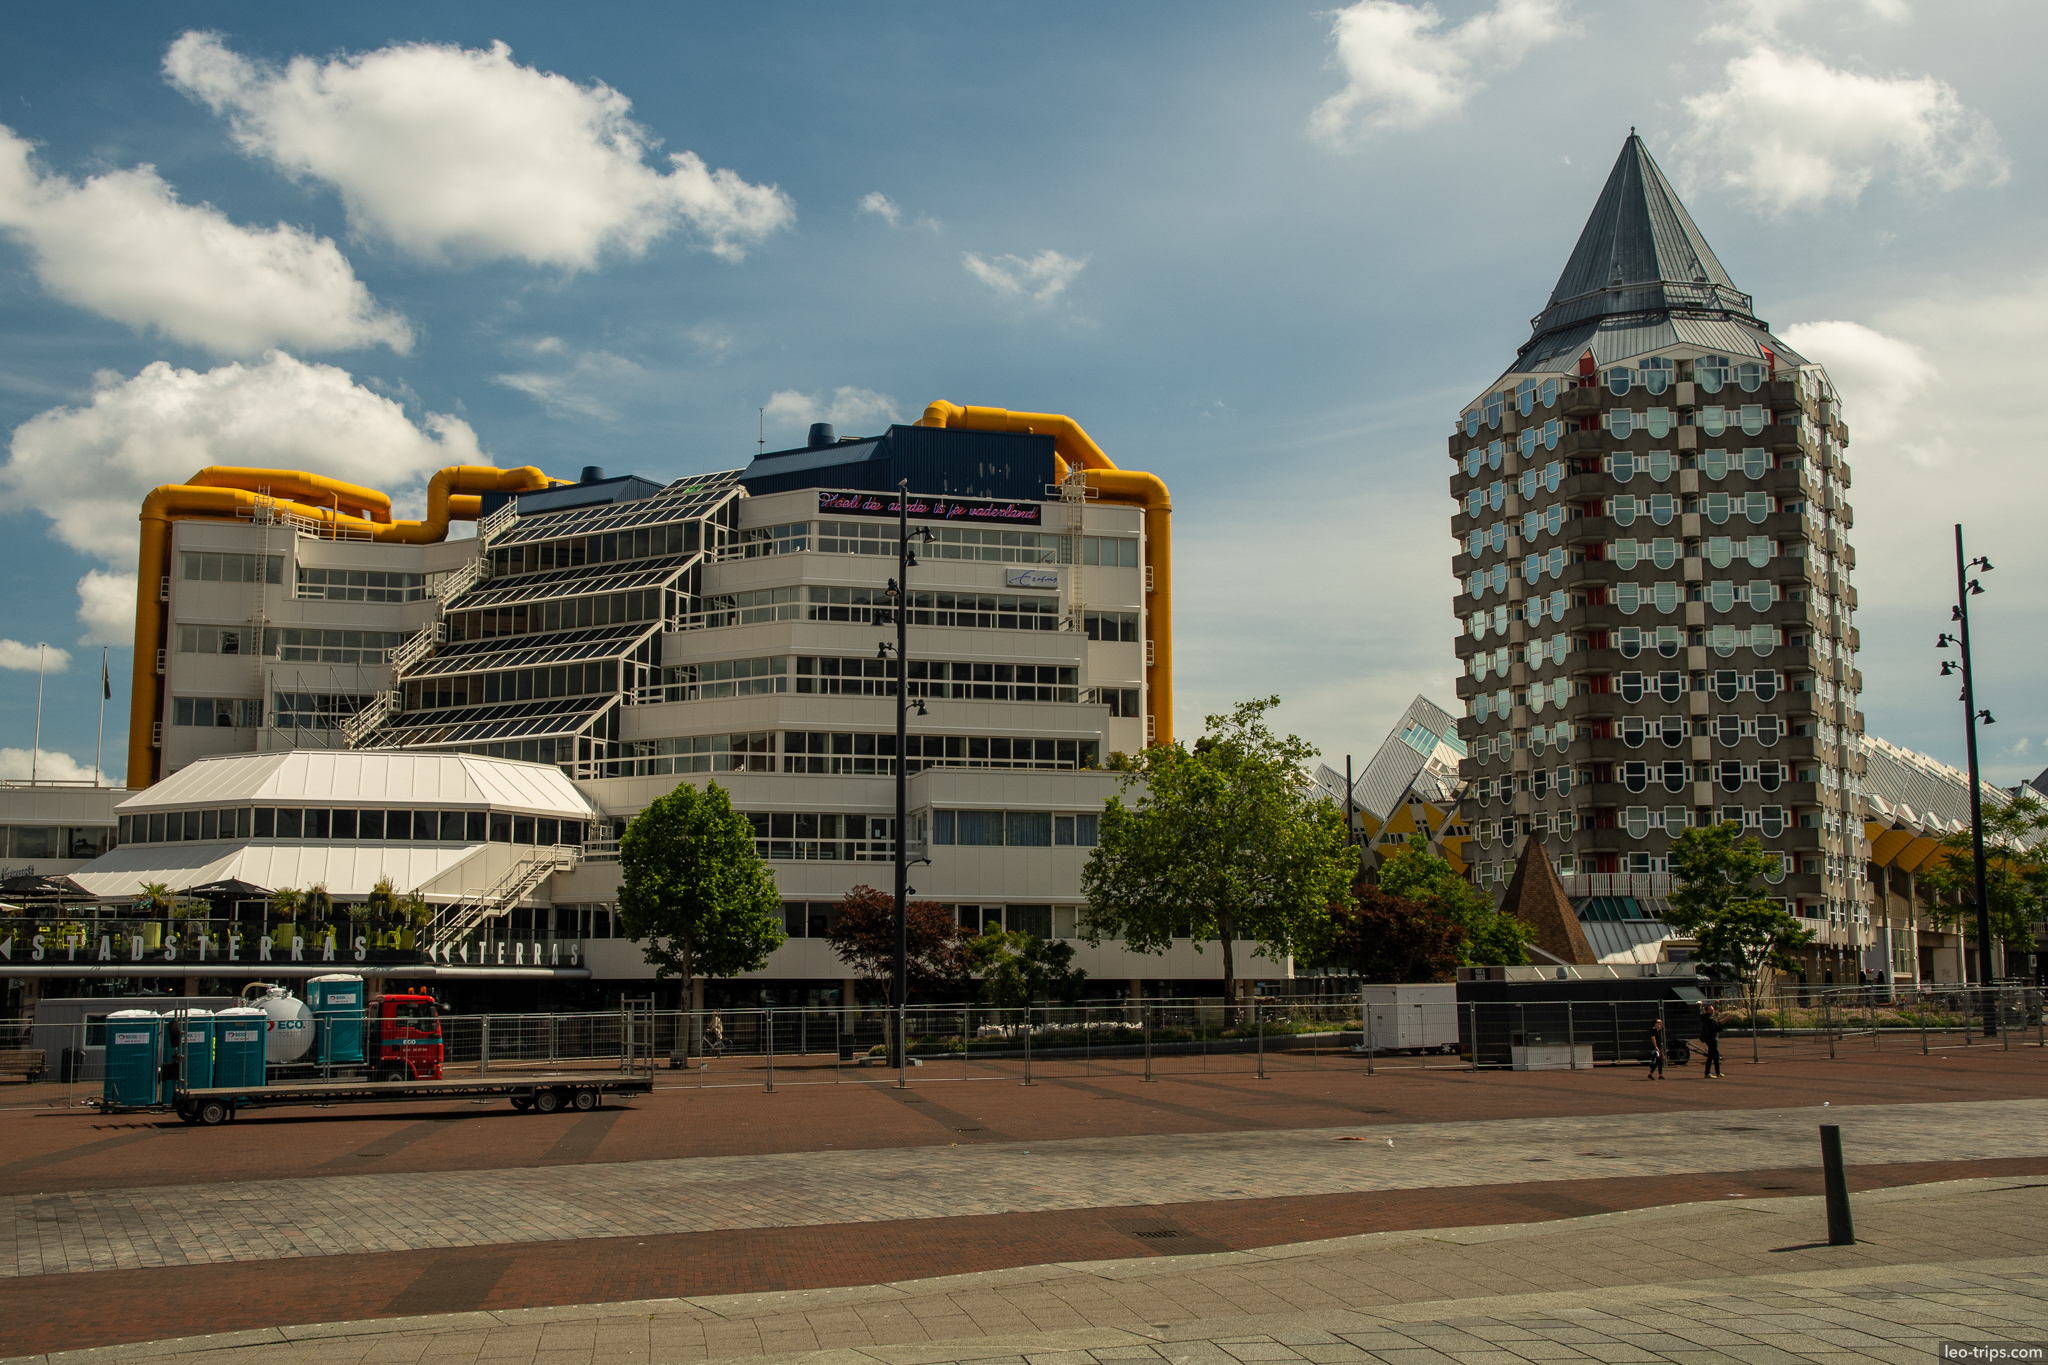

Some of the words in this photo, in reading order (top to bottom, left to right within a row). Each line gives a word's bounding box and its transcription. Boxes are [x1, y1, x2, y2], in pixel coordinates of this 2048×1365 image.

[862, 496, 883, 511] de
[933, 502, 947, 514] is
[946, 503, 967, 519] je
[969, 503, 1039, 519] vaderland
[32, 934, 367, 961] STADSTERRAS
[479, 941, 578, 966] TERRAS
